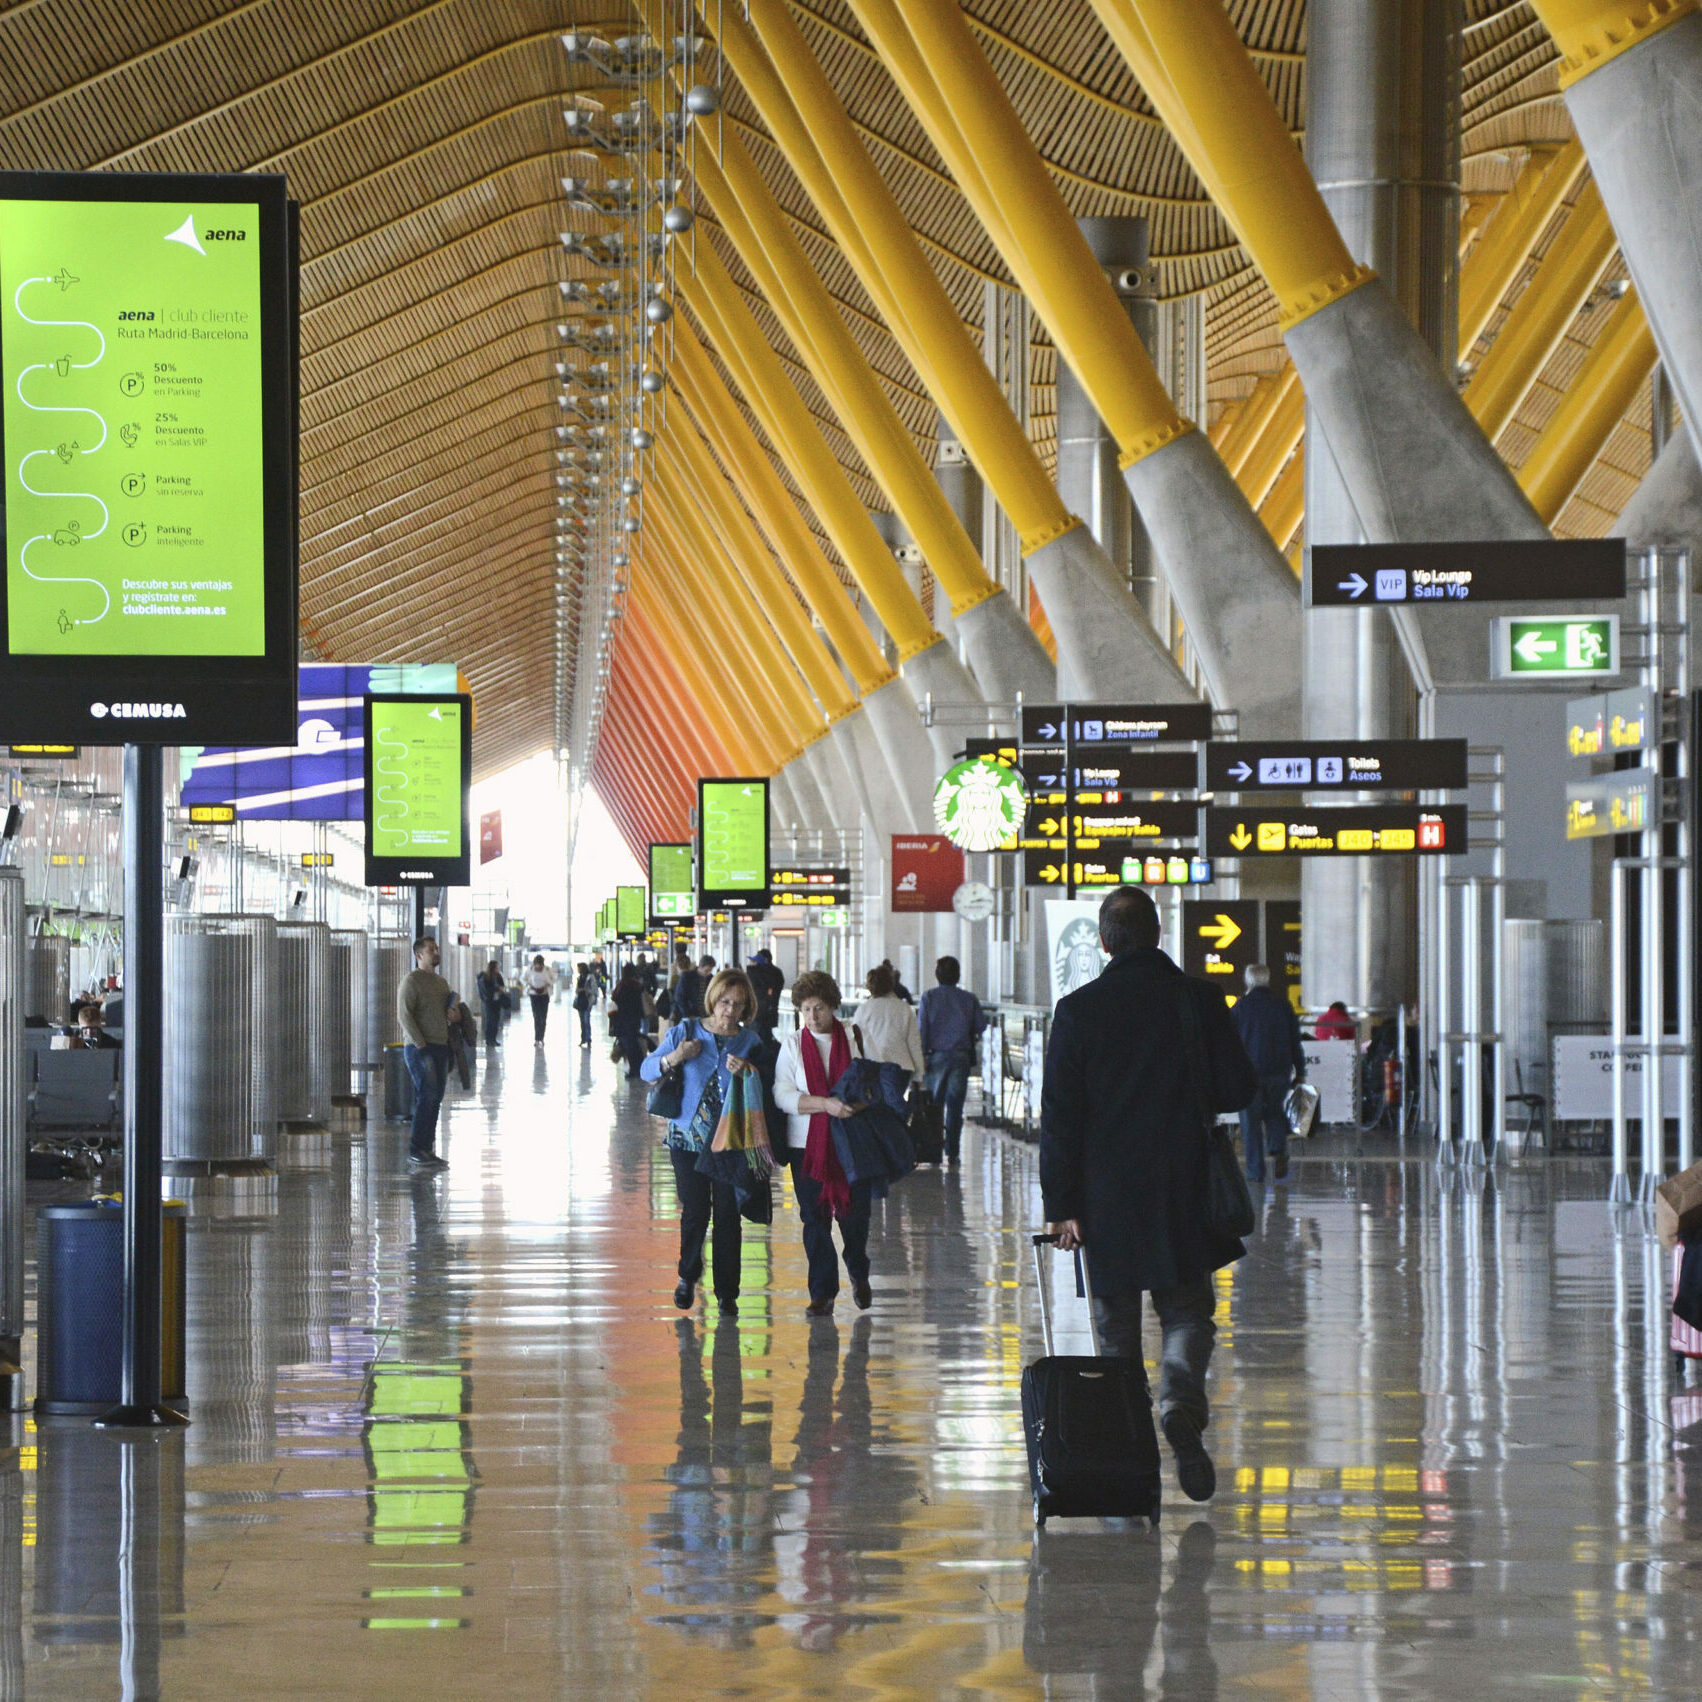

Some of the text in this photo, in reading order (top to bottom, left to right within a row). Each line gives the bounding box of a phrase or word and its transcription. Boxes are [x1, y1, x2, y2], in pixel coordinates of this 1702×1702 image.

[205, 230, 246, 241] aena
[118, 309, 249, 323] aena club cliente
[117, 328, 249, 340] Ruta Madrid-Barcelona
[154, 363, 177, 372] 50%
[154, 376, 203, 384] Descuento
[167, 387, 201, 398] Parking
[155, 413, 178, 422] 25%
[155, 426, 204, 435] Descuento
[170, 439, 191, 447] Salas
[193, 439, 208, 447] VIP
[156, 475, 191, 486] Parking
[157, 525, 192, 536] Parking
[157, 538, 204, 548] inteligente
[1413, 570, 1472, 584] Vip Lounge
[122, 579, 232, 592] Descubre sus ventajas
[1381, 578, 1402, 591] VIP
[1413, 585, 1469, 599] Sala Vip
[122, 594, 129, 603] y
[181, 594, 197, 602] en:
[122, 604, 227, 615] clubcliente.aena.es
[110, 703, 187, 718] CEMUSA
[1107, 729, 1159, 739] Zona Infantil
[1348, 757, 1380, 770] Toilets
[1350, 770, 1382, 781] Aseos
[1084, 778, 1118, 788] Sala Vip
[1289, 824, 1318, 836] Gates
[1424, 825, 1440, 845] H
[896, 842, 928, 850] IBERIA
[1289, 835, 1334, 849] Puertas
[1196, 866, 1206, 879] U
